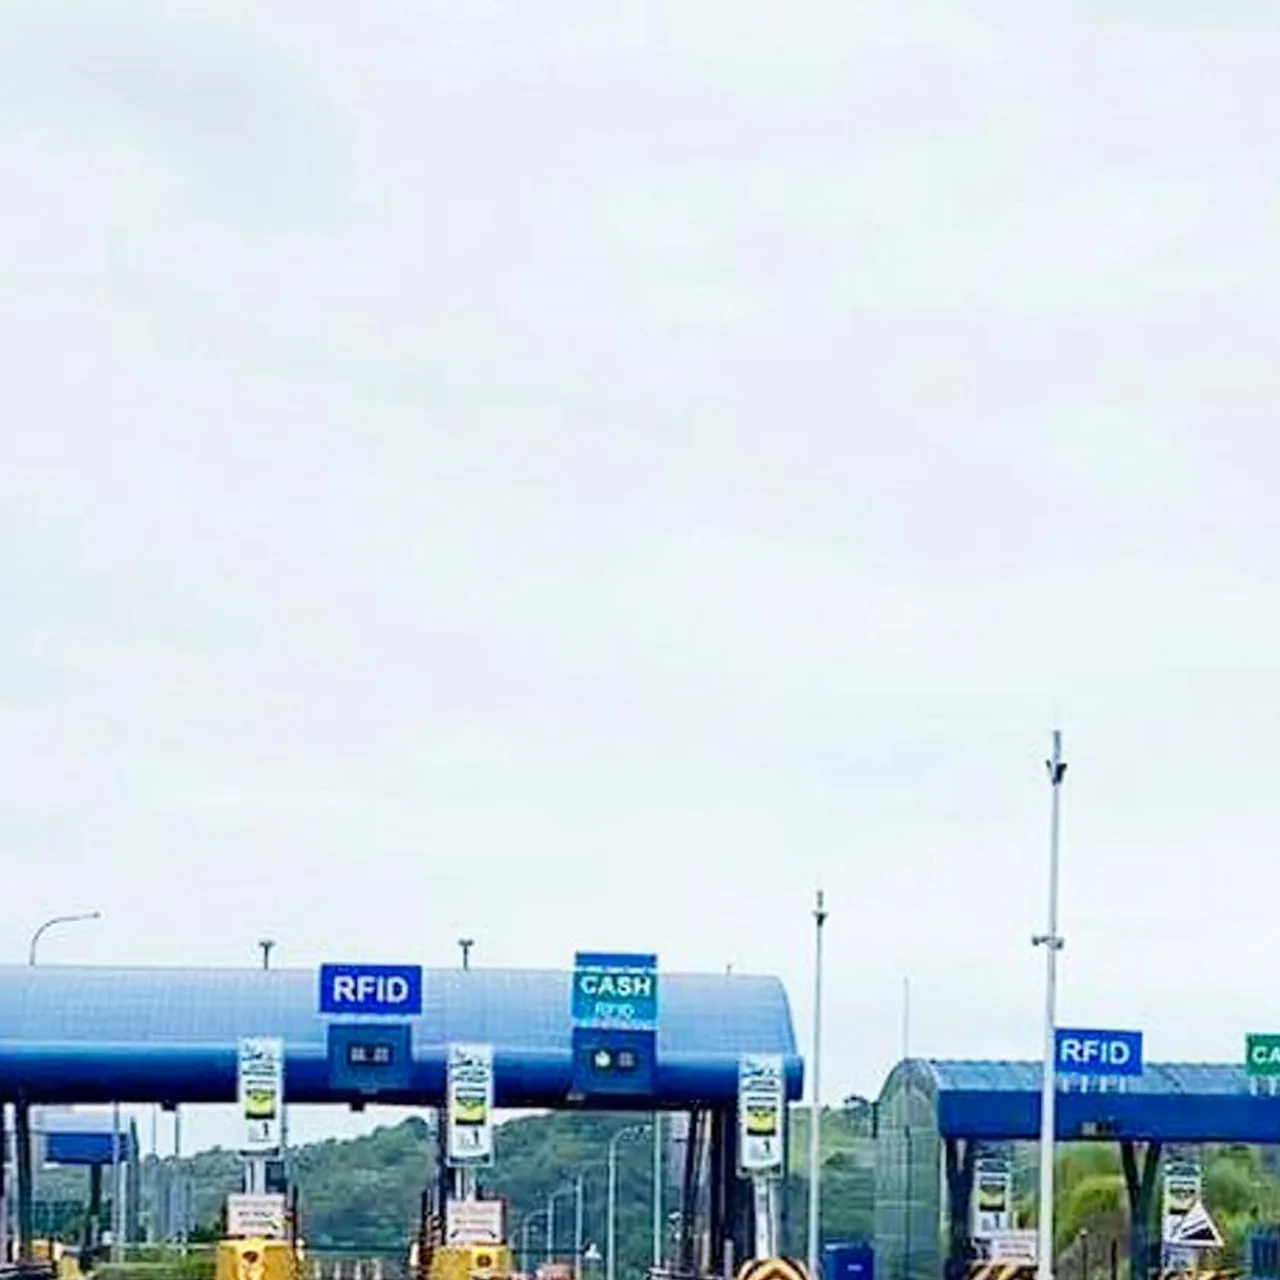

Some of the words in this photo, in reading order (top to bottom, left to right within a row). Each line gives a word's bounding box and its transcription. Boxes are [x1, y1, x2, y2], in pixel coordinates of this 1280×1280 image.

[333, 975, 409, 1003] RFID
[581, 976, 651, 997] CASH
[1060, 1037, 1130, 1065] RFID
